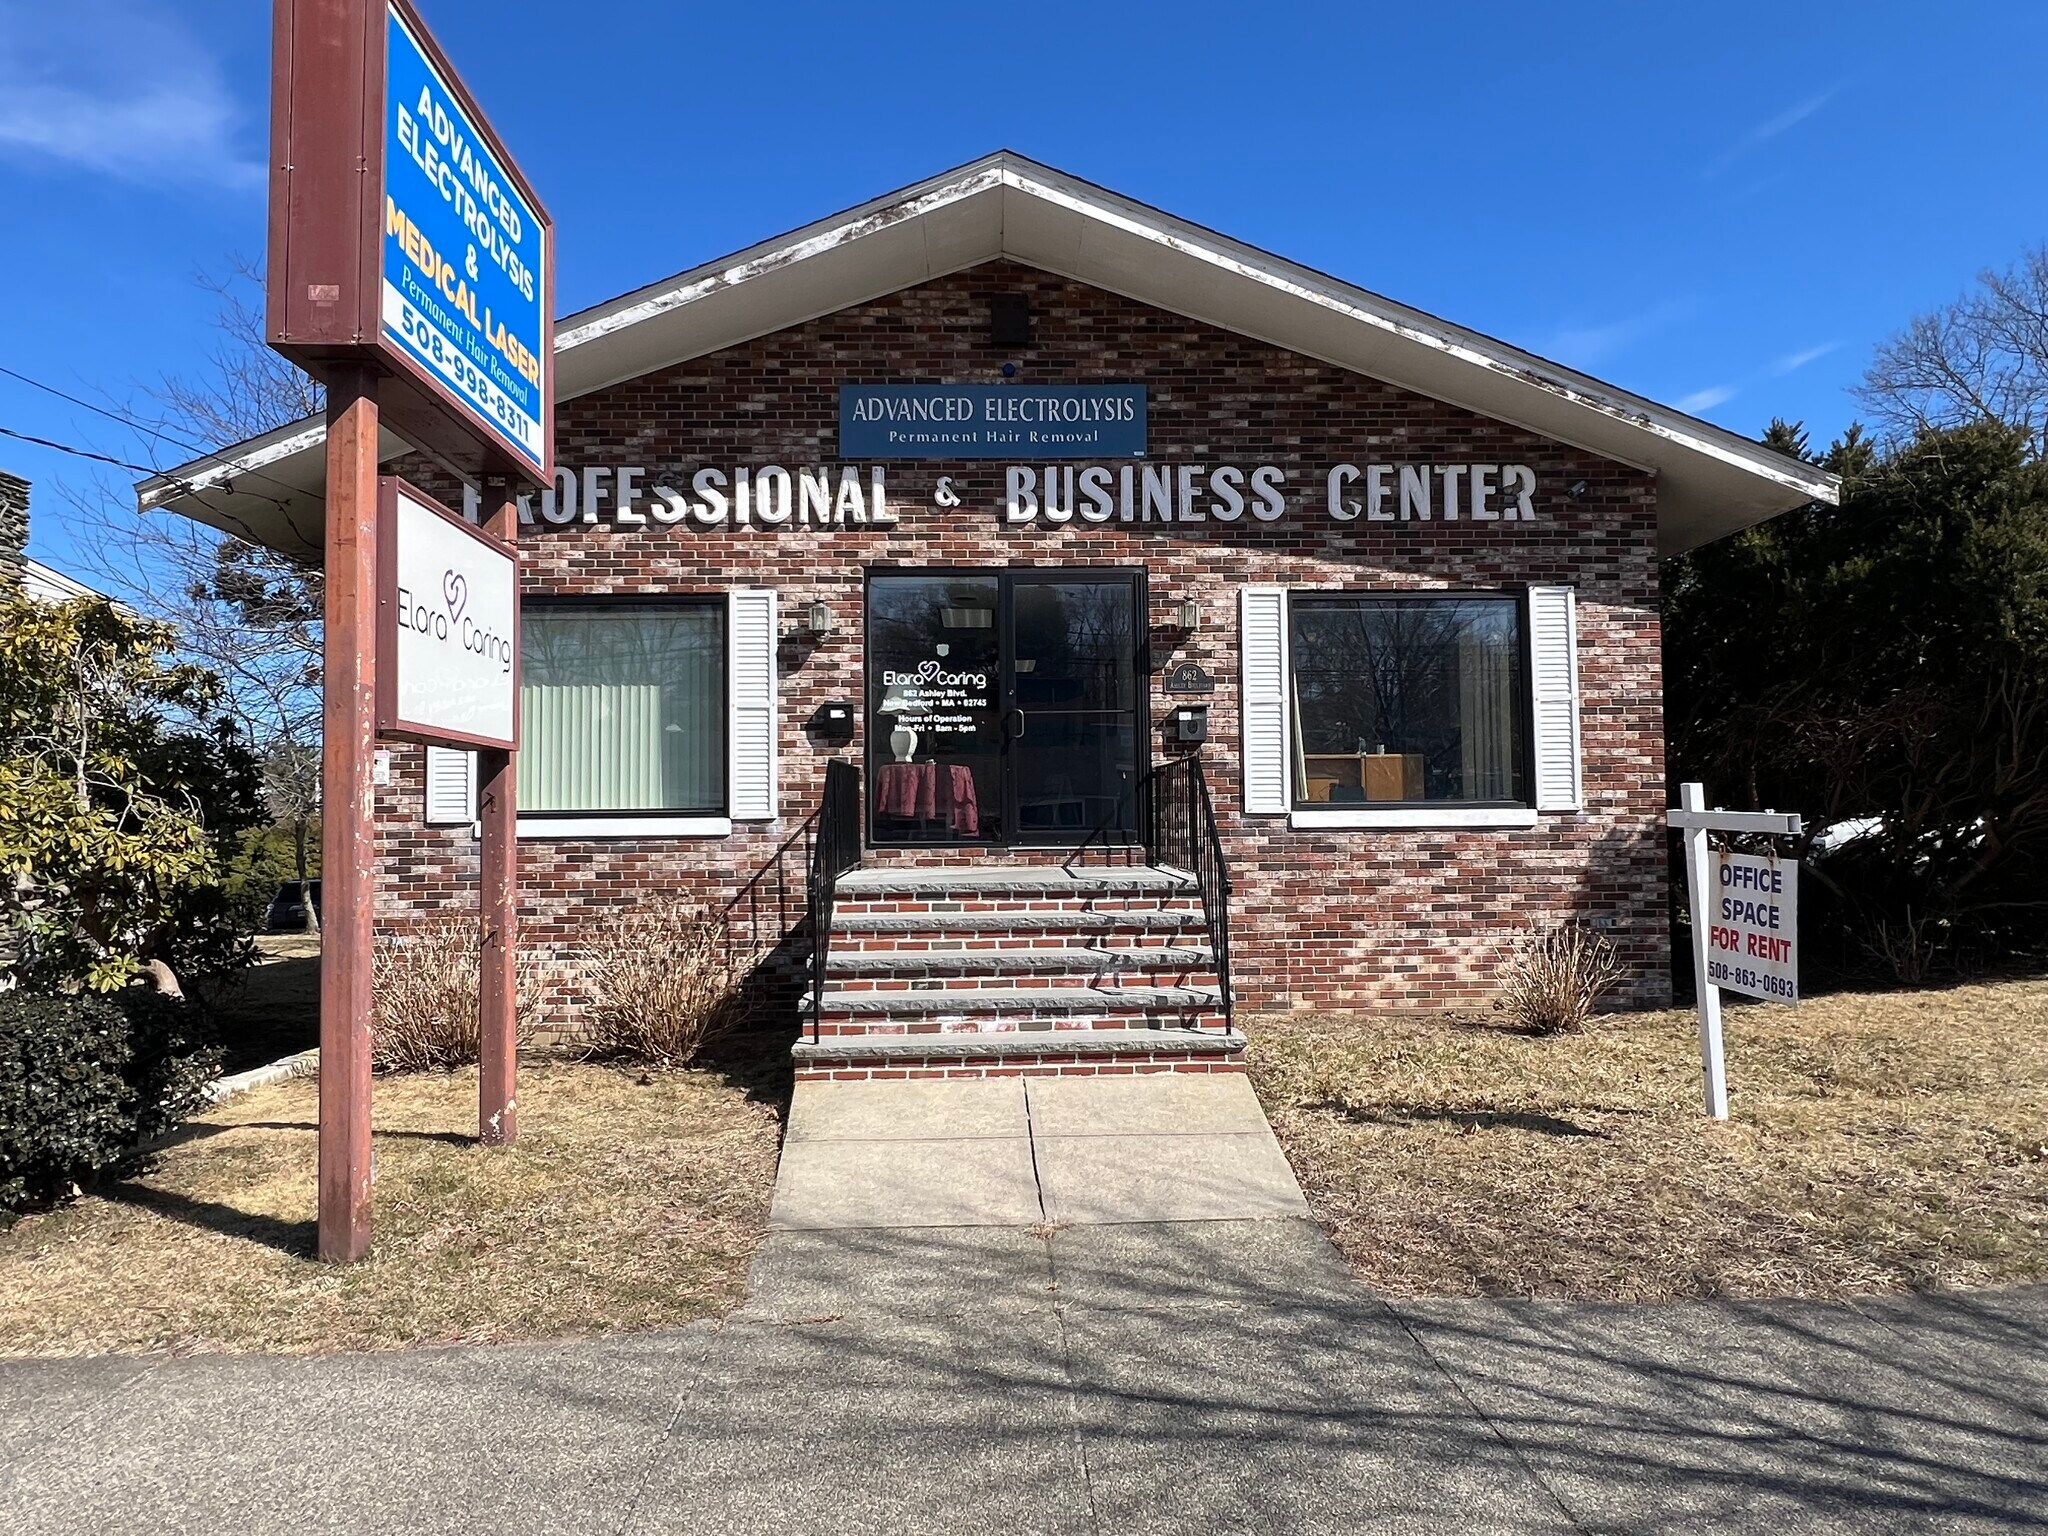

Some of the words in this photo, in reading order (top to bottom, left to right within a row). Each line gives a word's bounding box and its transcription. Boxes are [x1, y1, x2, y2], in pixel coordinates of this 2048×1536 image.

[418, 85, 521, 244] ADVANCED
[398, 101, 534, 302] ELECTROLYSIS
[465, 243, 479, 282] &
[386, 194, 482, 332] MEDICAL
[485, 306, 539, 390] LASER
[402, 264, 464, 344] Permanent
[466, 330, 489, 368] Hair
[490, 354, 528, 406] Removal
[402, 303, 530, 442] 508-998-8311
[852, 397, 974, 422] ADVANCED
[985, 397, 1134, 422] ELECTROLYSIS
[889, 430, 978, 443] Permanent
[986, 430, 1021, 443] Hair
[1030, 430, 1099, 443] Removal
[934, 476, 961, 507] &
[1006, 465, 1285, 523] BUSINESS
[1327, 464, 1537, 521] CENTER
[397, 586, 448, 642] Elara
[463, 616, 511, 673] Caring
[883, 671, 925, 686] Elara
[937, 671, 987, 689] Caring
[1182, 669, 1197, 681] 862
[919, 690, 946, 699] Ashley
[941, 699, 955, 707] MA
[933, 715, 972, 724] Operation
[1720, 864, 1782, 893] OFFICE
[1722, 898, 1779, 929] SPACE
[1711, 925, 1739, 952] FOR
[1747, 932, 1791, 963] RENT
[1709, 961, 1794, 998] 508-863-0693
